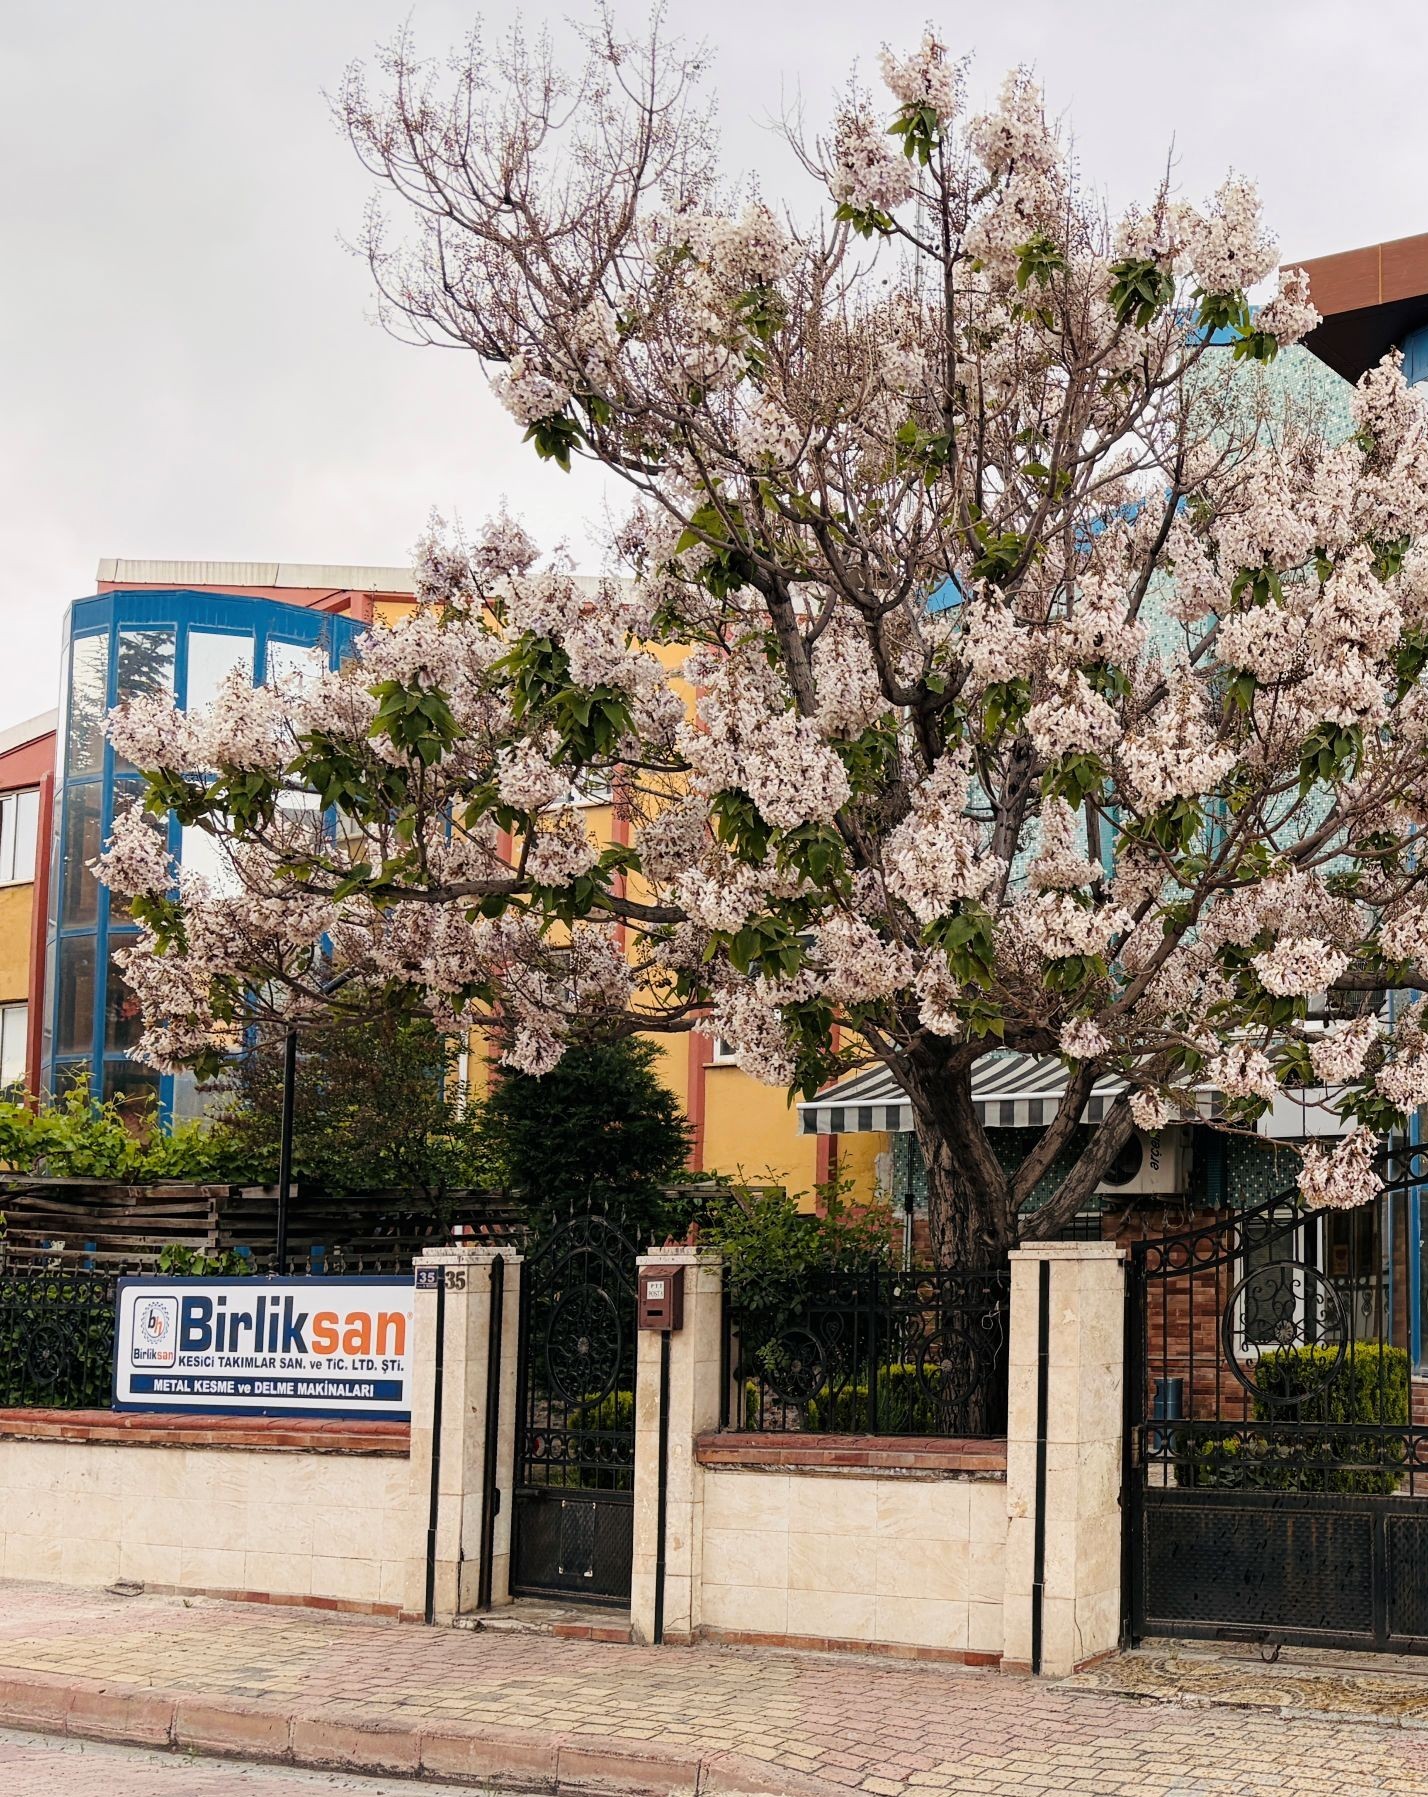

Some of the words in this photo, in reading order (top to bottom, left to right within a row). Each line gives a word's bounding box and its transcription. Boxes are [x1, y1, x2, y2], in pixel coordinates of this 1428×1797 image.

[419, 1272, 436, 1283] 35
[445, 1271, 466, 1290] 35
[133, 1348, 174, 1360] Birliksan
[218, 1357, 276, 1369] TAKIMLAR
[280, 1358, 306, 1369] SAN.
[310, 1361, 322, 1370] ve
[352, 1359, 378, 1371] LTD.
[153, 1378, 191, 1392] METAL
[194, 1380, 235, 1393] KESME
[238, 1384, 252, 1394] ve
[254, 1382, 294, 1395] DELME
[297, 1380, 375, 1397] MAKİNALARI
